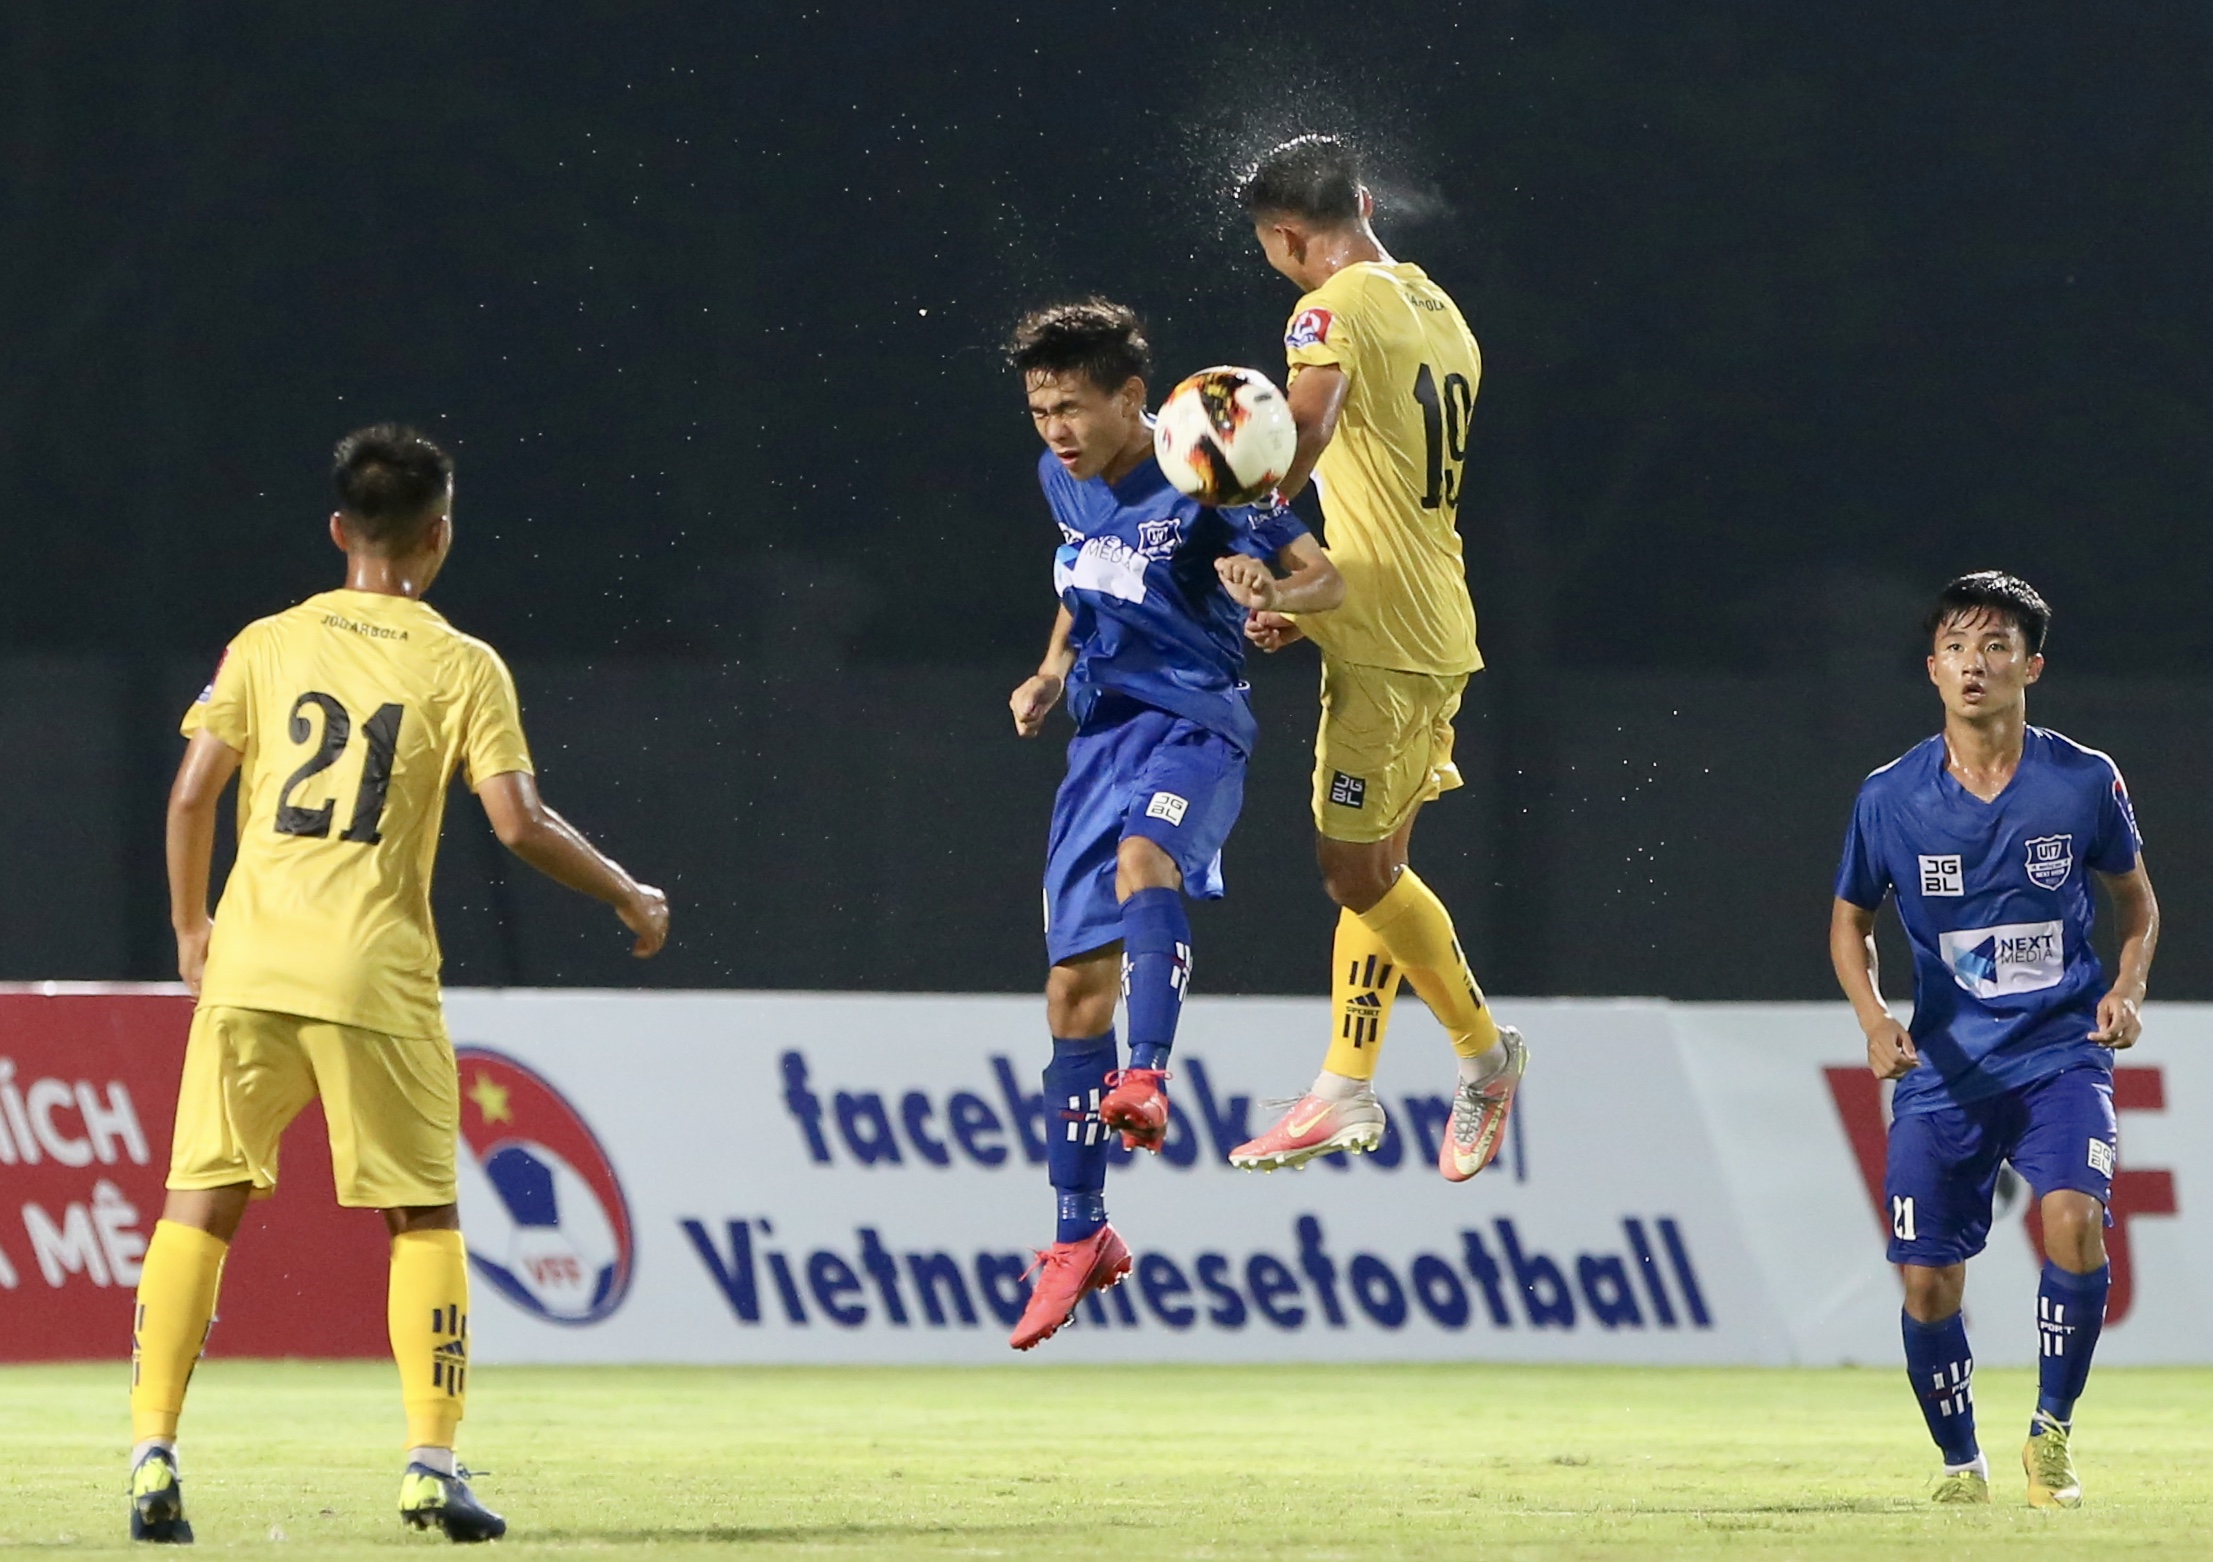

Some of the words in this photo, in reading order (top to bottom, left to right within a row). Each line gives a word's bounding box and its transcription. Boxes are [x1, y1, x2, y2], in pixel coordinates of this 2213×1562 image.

[1413, 362, 1472, 508] 19
[274, 691, 404, 845] 21
[2001, 934, 2053, 952] NEXT
[2001, 948, 2053, 965] MEDIA
[21, 1178, 146, 1289] MÊ
[1892, 1194, 1917, 1240] 21
